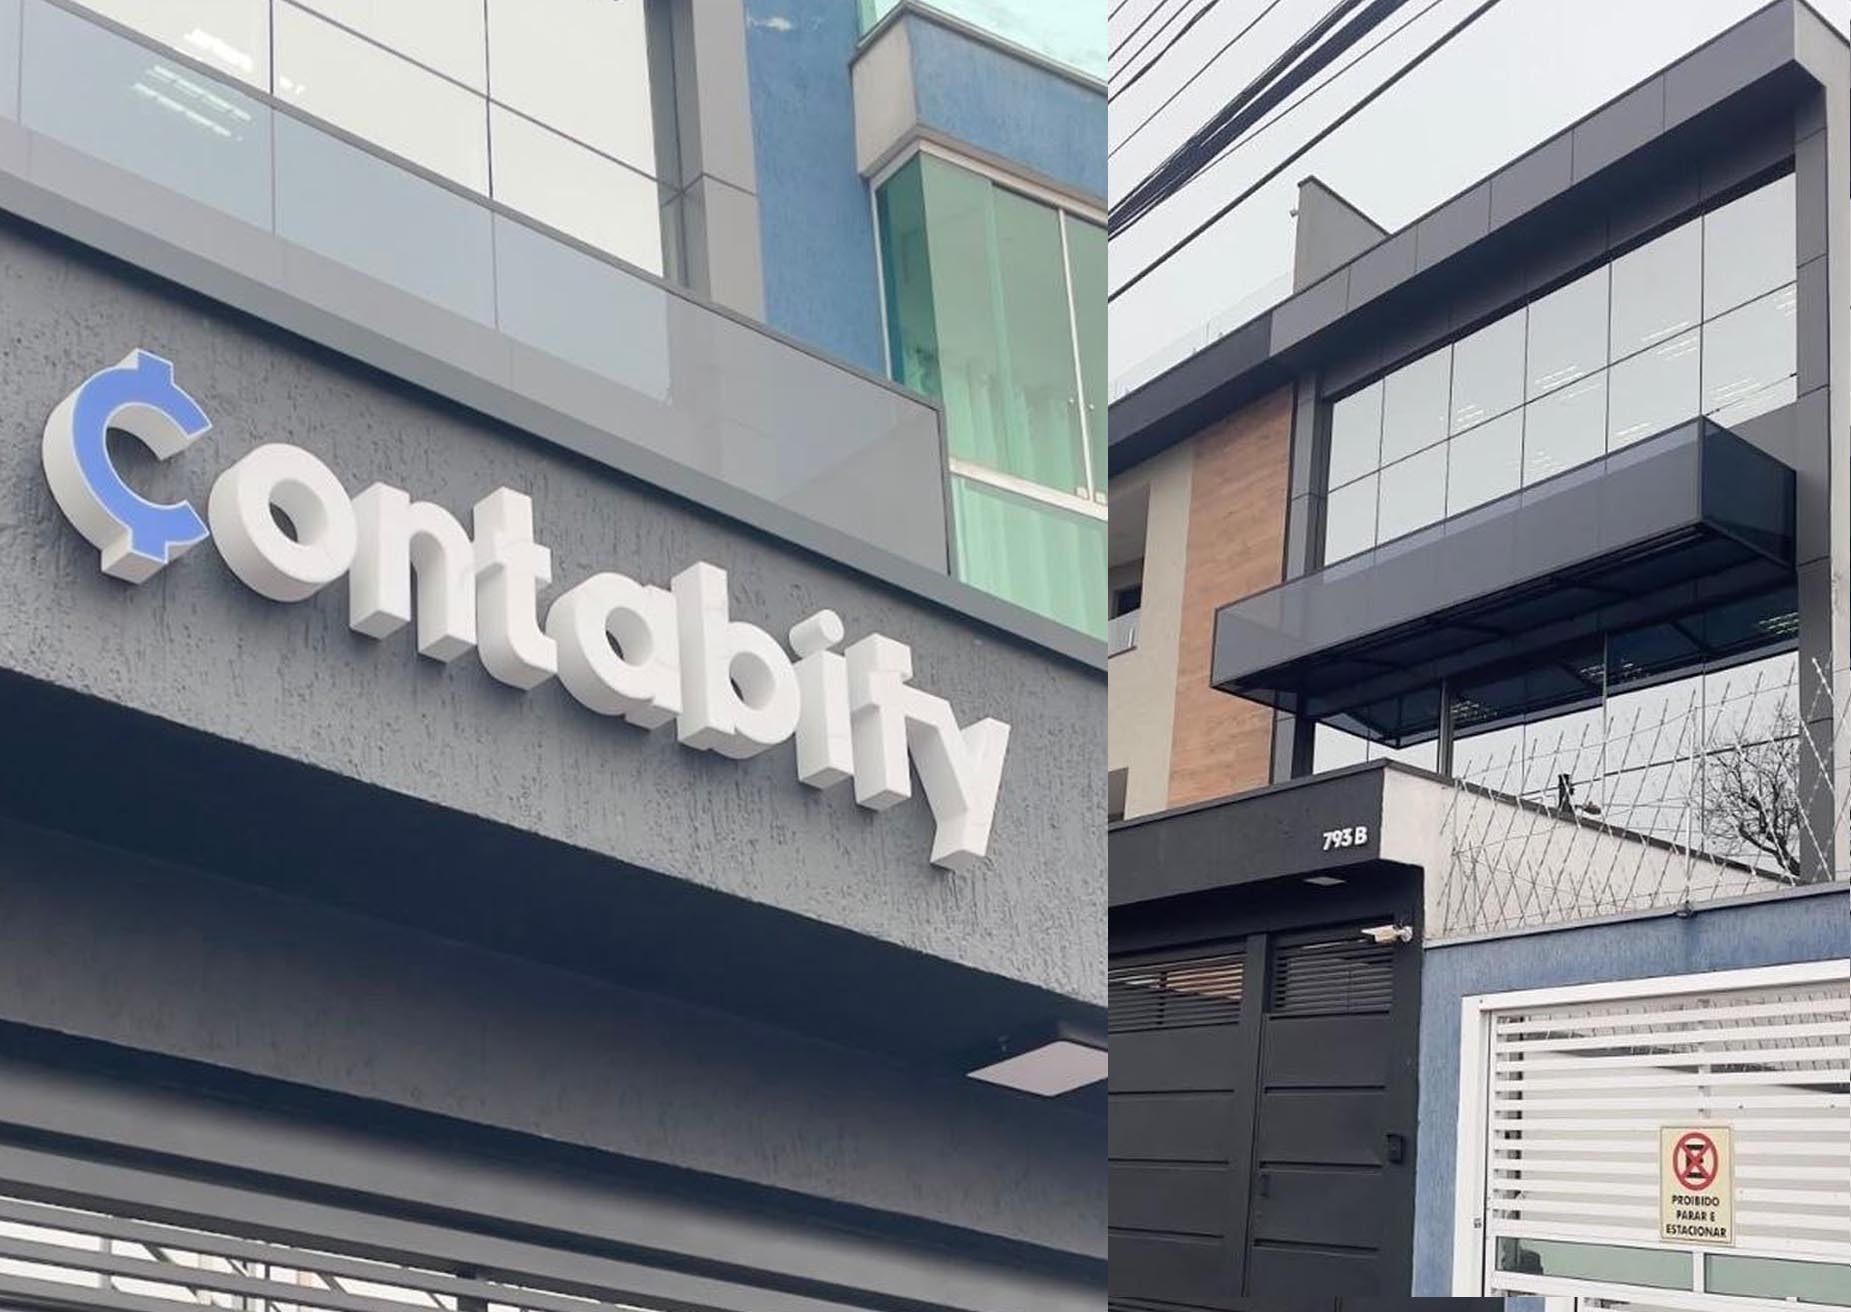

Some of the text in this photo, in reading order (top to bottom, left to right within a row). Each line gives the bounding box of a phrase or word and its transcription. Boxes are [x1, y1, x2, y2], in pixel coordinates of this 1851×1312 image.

[41, 347, 1011, 870] Contabify
[1323, 826, 1368, 850] 793 B
[1671, 1195, 1720, 1206] PROIBIDO
[1676, 1210, 1716, 1221] PARAR E
[1665, 1224, 1727, 1237] ESTACIONAR
